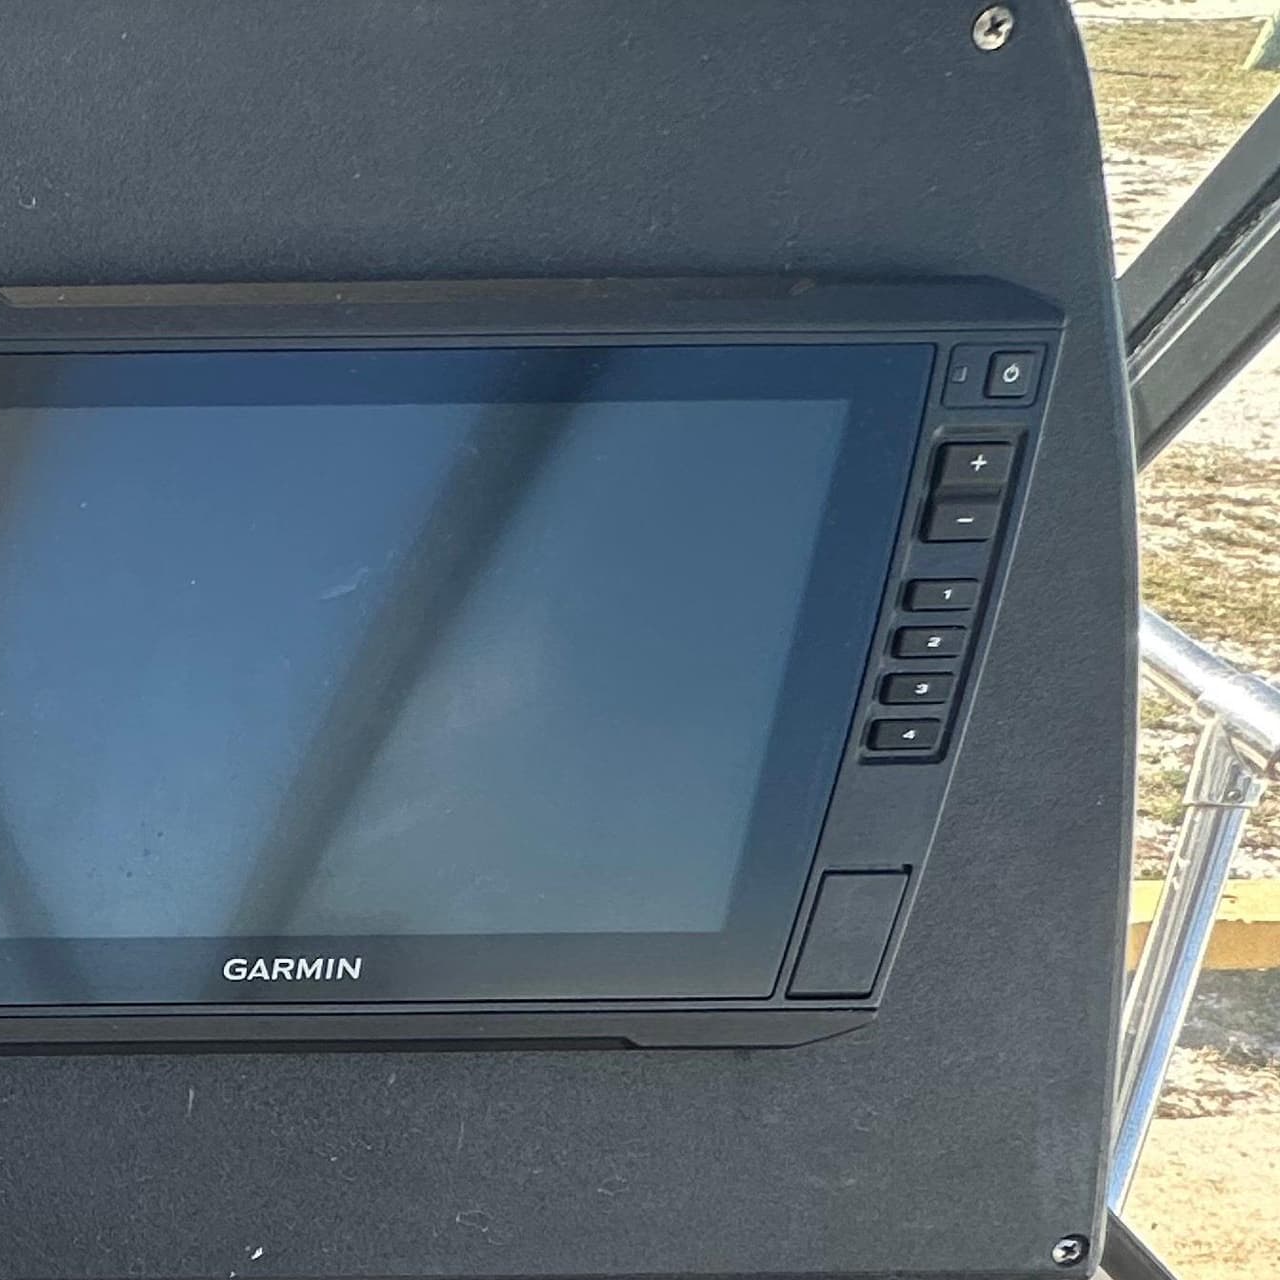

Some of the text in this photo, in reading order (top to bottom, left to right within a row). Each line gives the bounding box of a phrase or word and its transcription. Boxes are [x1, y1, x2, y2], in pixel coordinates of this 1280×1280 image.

[943, 589, 953, 600] 1
[927, 636, 942, 648] 2
[915, 683, 929, 694] 3
[902, 729, 916, 739] 4
[223, 957, 362, 981] GARMIN
